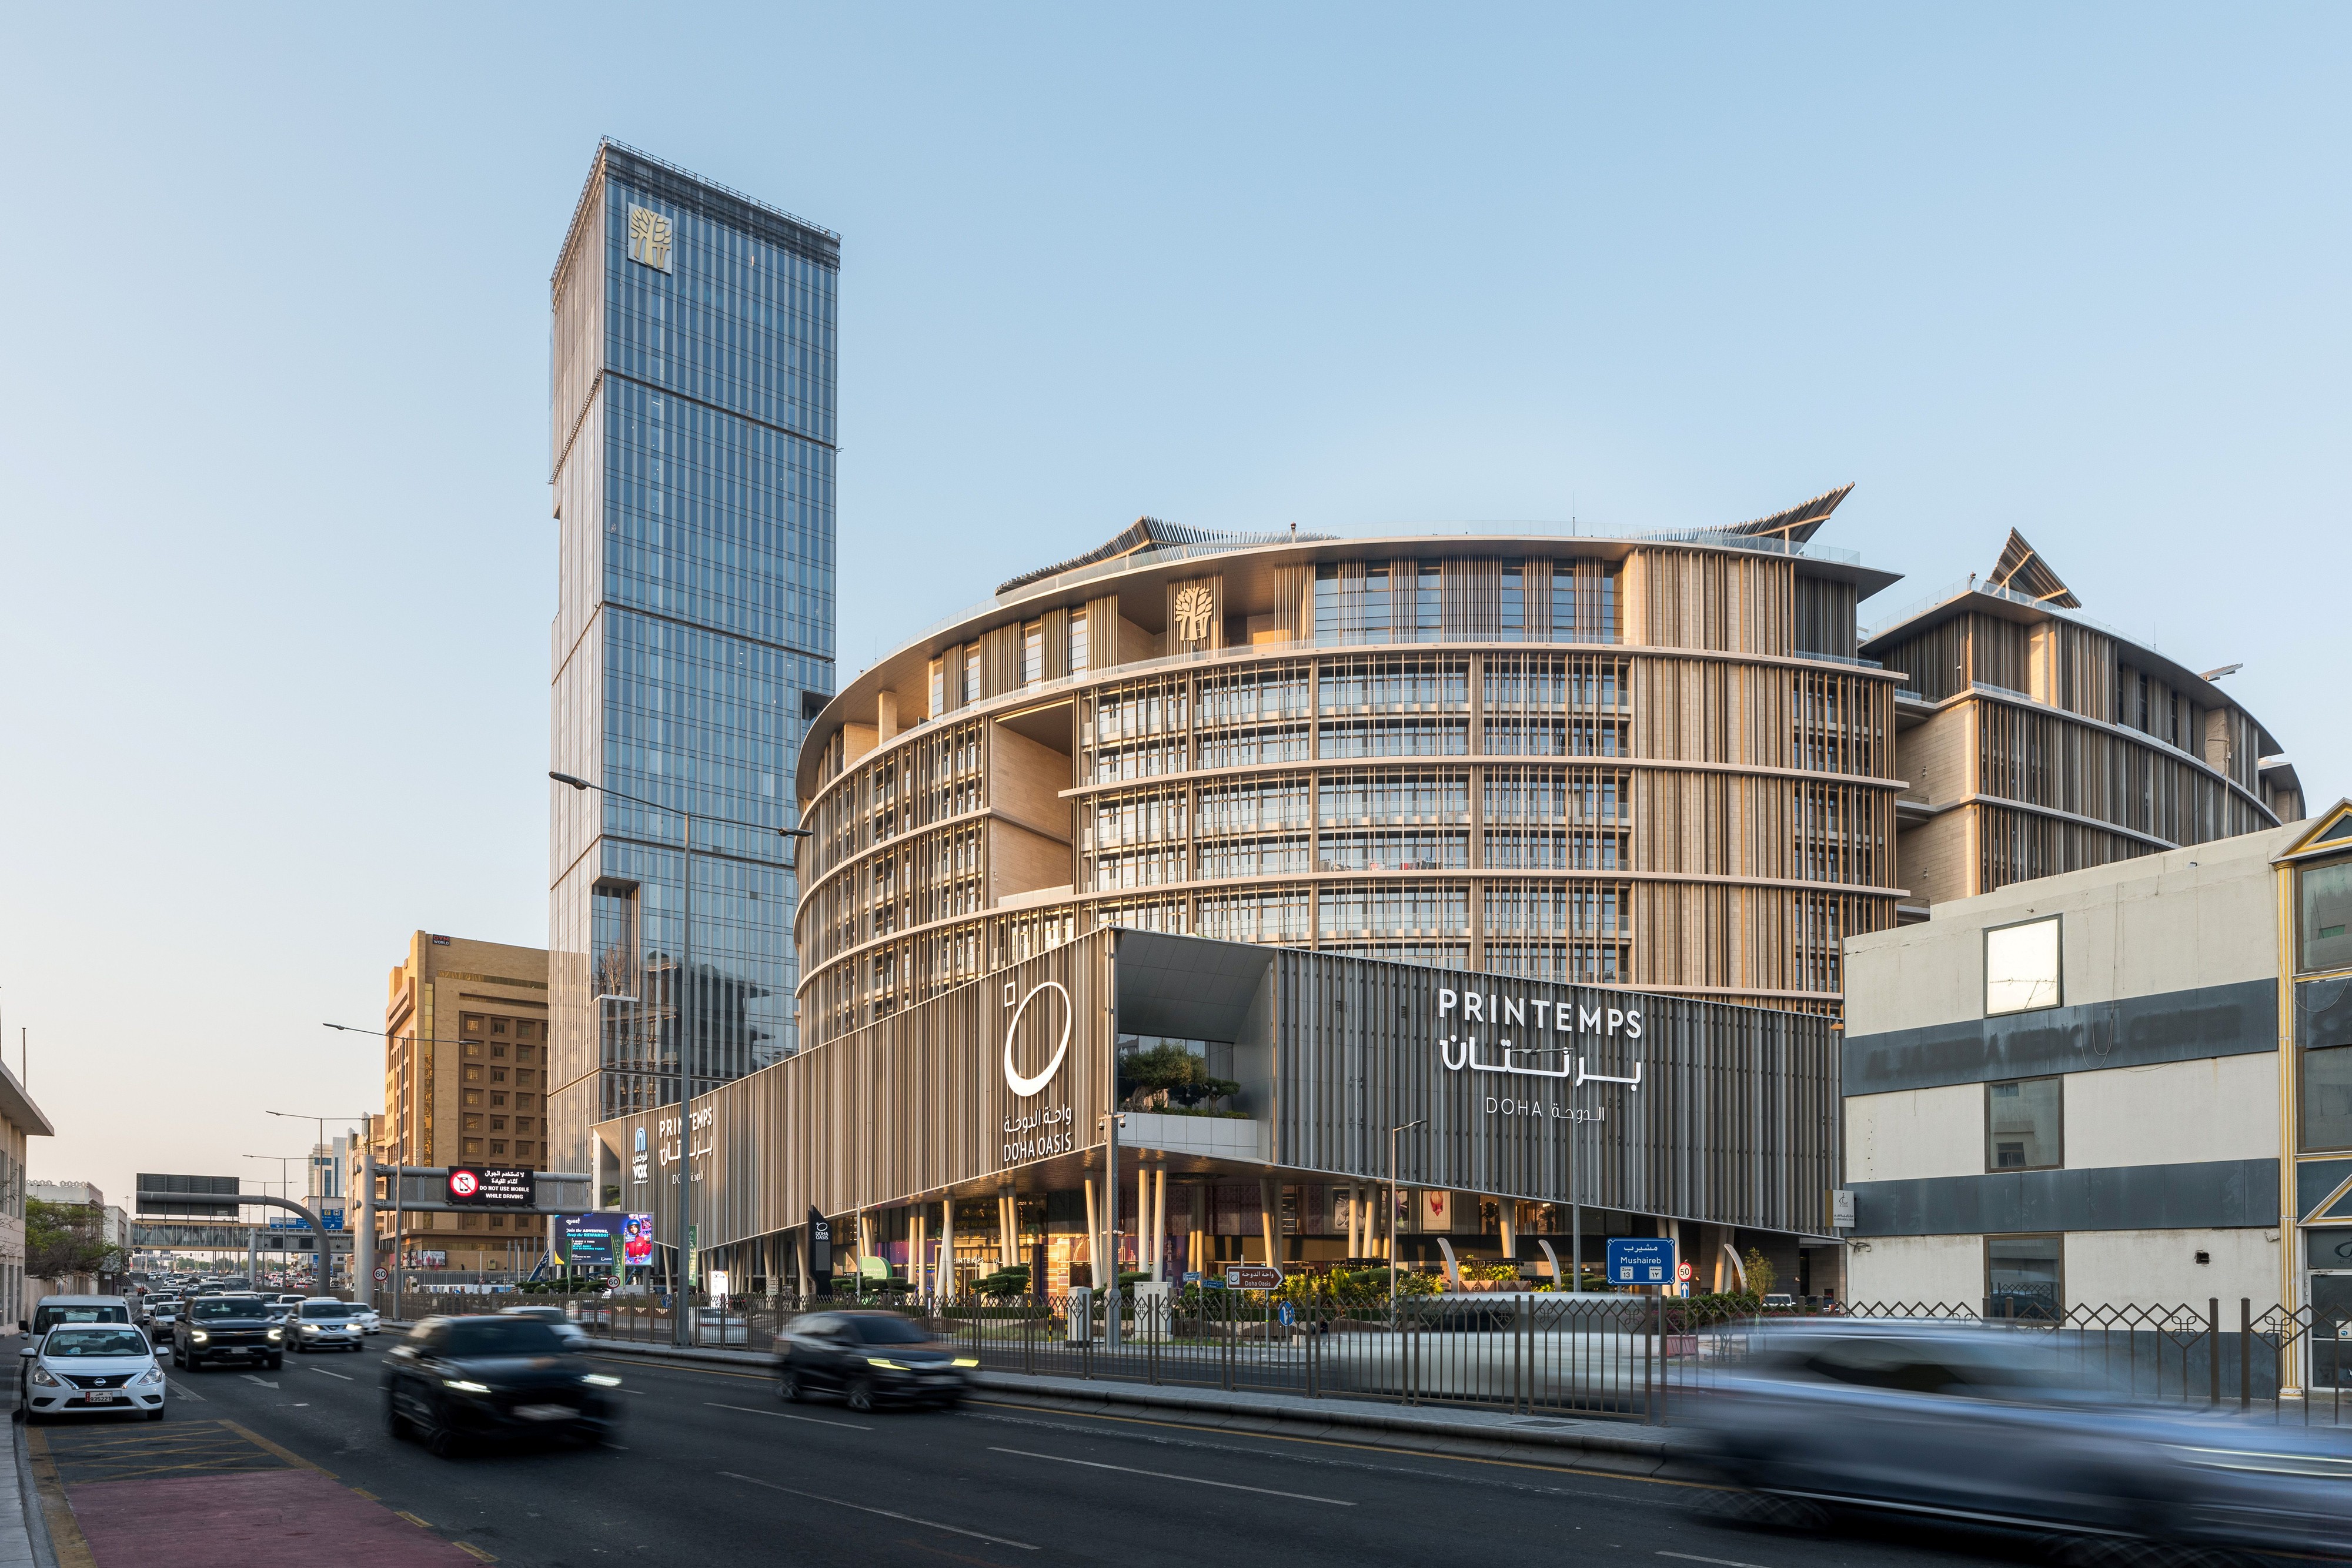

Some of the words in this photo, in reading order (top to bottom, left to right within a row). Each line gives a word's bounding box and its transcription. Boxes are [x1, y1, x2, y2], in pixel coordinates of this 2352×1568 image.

[1439, 988, 1642, 1039] PRINTEMPS
[1439, 1034, 1642, 1092] برنتان
[1004, 1109, 1042, 1135] الدوحة
[1043, 1103, 1073, 1126] واحة
[1486, 1096, 1542, 1118] DOHA
[1551, 1103, 1605, 1124] الدوحة
[1004, 1138, 1035, 1162] DOHA
[1038, 1131, 1073, 1156] OASIS
[633, 1164, 648, 1179] VOX
[566, 1217, 580, 1225] quest
[689, 1231, 697, 1281] PRINTEMPS
[1623, 1243, 1658, 1253] مشيرب
[1241, 1271, 1261, 1279] الدوحة
[1680, 1268, 1690, 1276] 50
